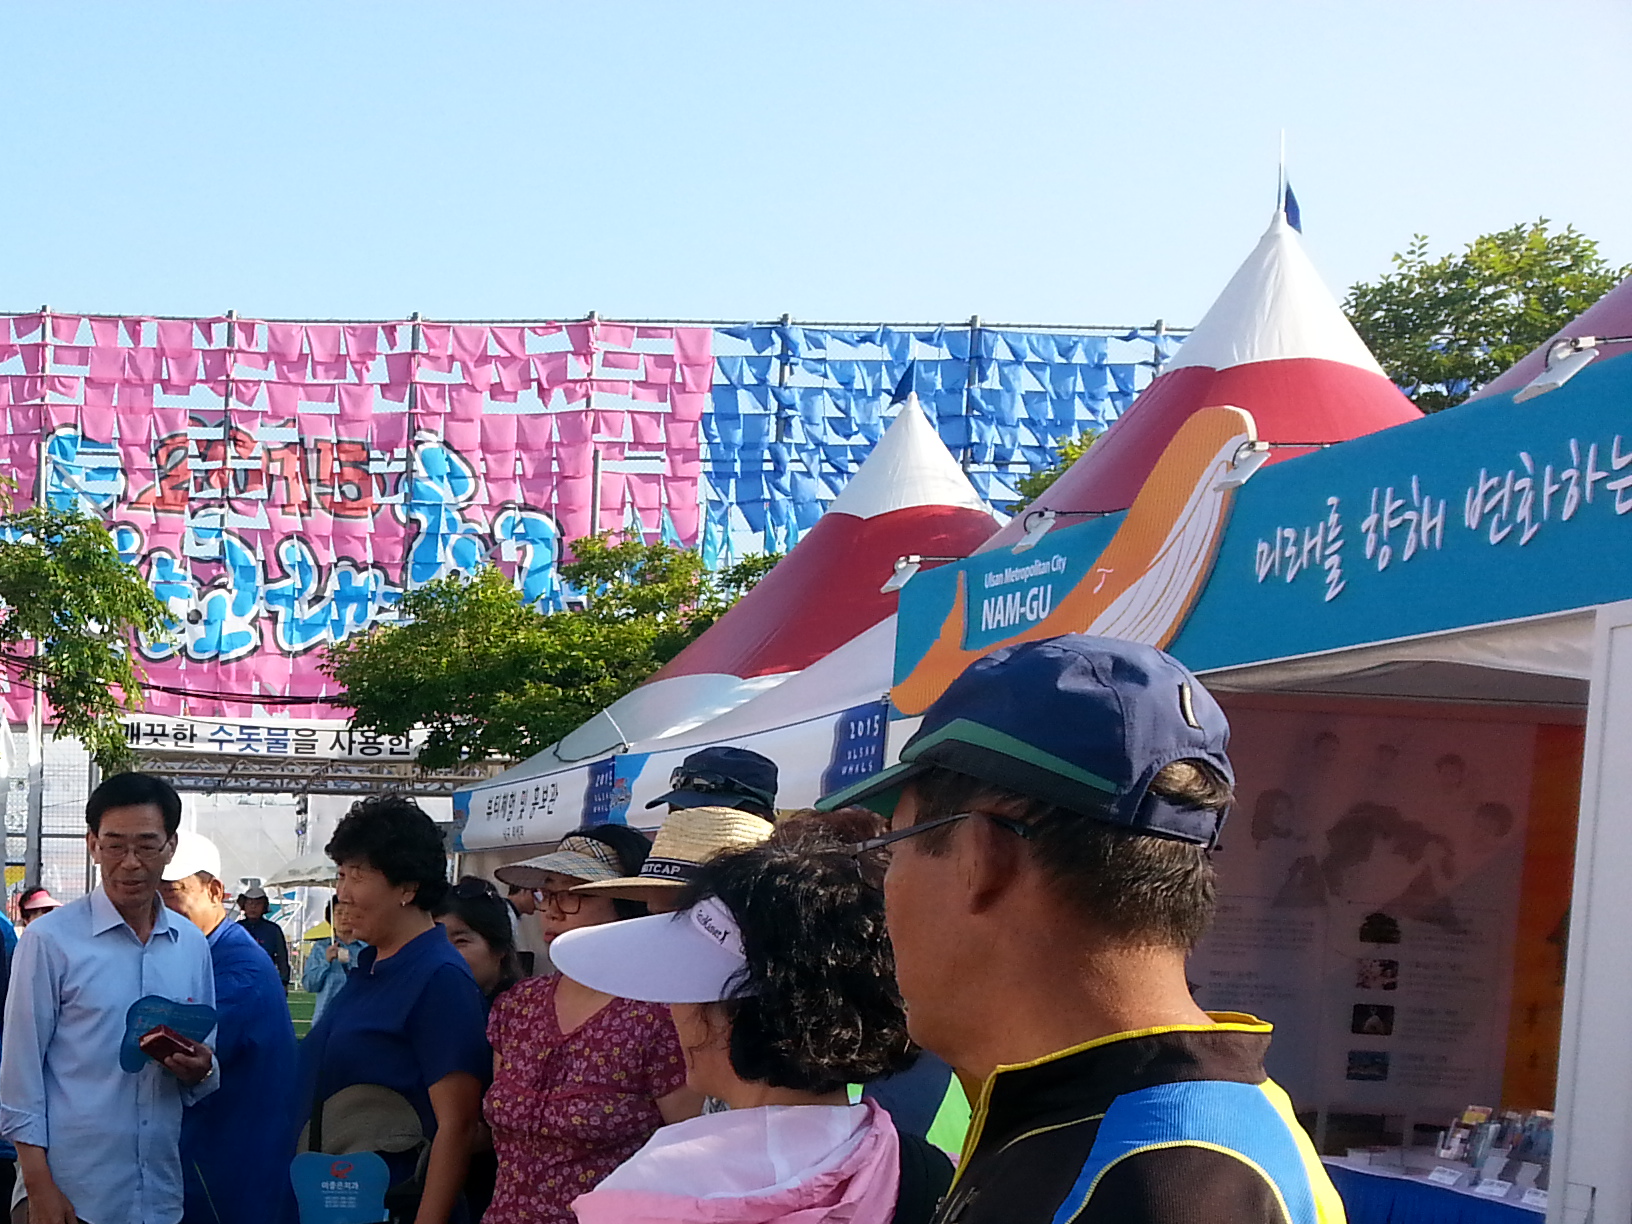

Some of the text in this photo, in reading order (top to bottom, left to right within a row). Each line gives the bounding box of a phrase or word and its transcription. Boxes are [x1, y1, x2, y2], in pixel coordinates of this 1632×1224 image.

[1255, 434, 1632, 602] 미래를 향해 변화하는
[984, 553, 1067, 589] Ulsan Metropolitan City
[981, 584, 1052, 632] NAM-GU
[207, 724, 319, 755] 수돗물을
[329, 728, 414, 757] 사용한
[849, 714, 880, 740] 2015
